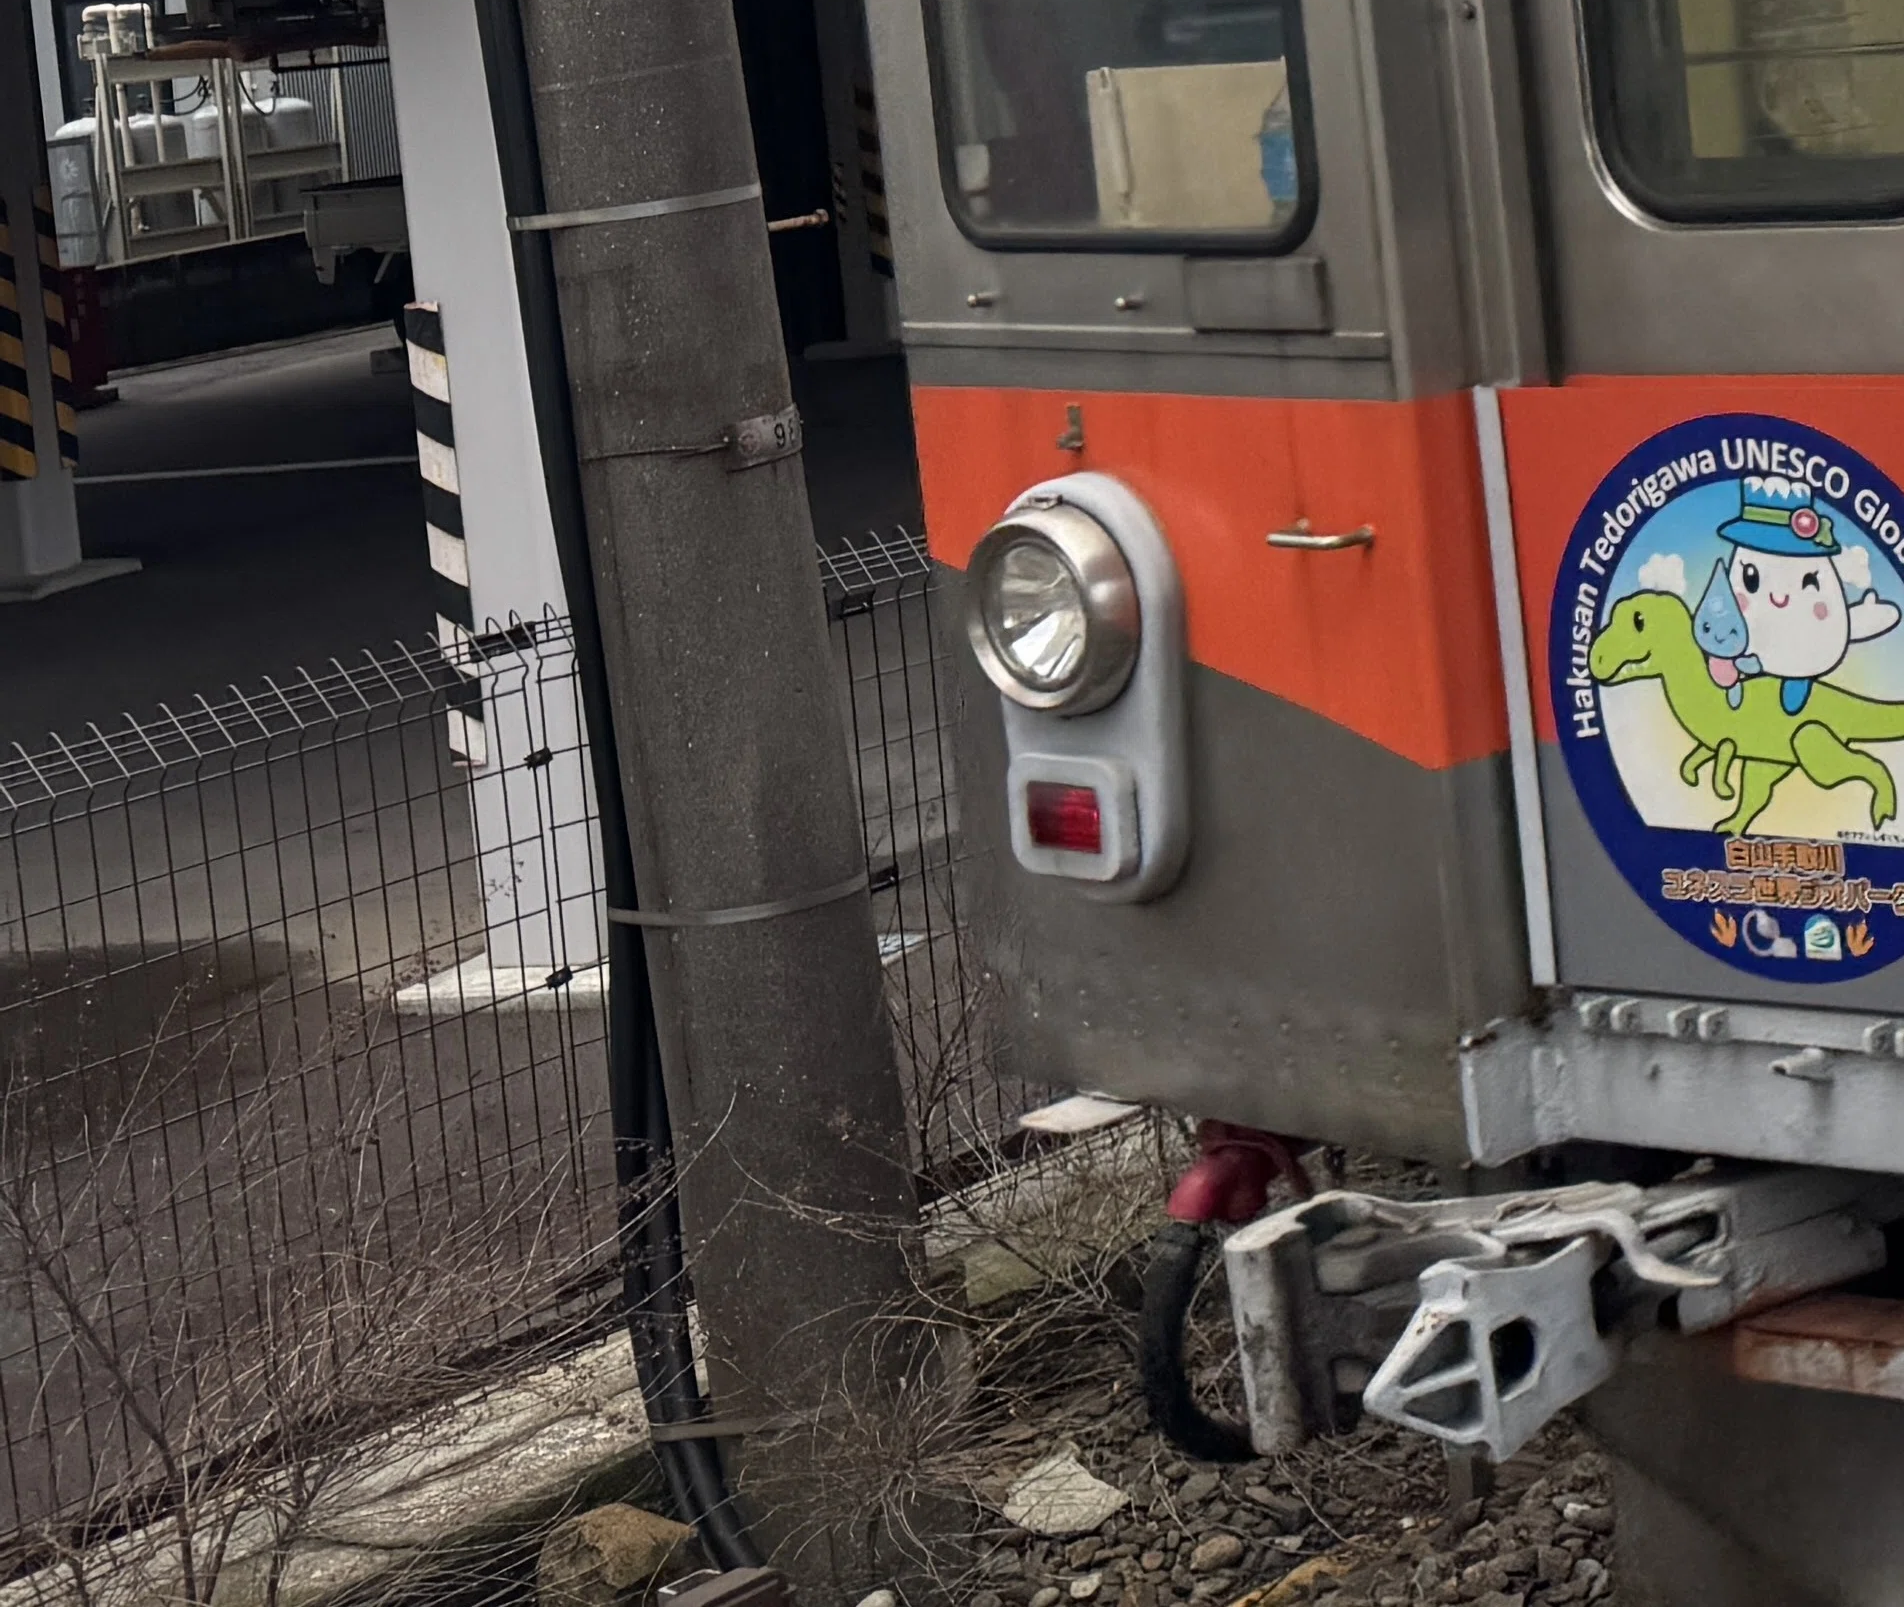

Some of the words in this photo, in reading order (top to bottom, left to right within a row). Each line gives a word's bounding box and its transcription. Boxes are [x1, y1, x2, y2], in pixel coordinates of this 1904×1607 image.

[1579, 448, 1717, 577] Tedorigawa
[1720, 437, 1851, 500] UNESCO
[1565, 581, 1601, 739] Hakusan
